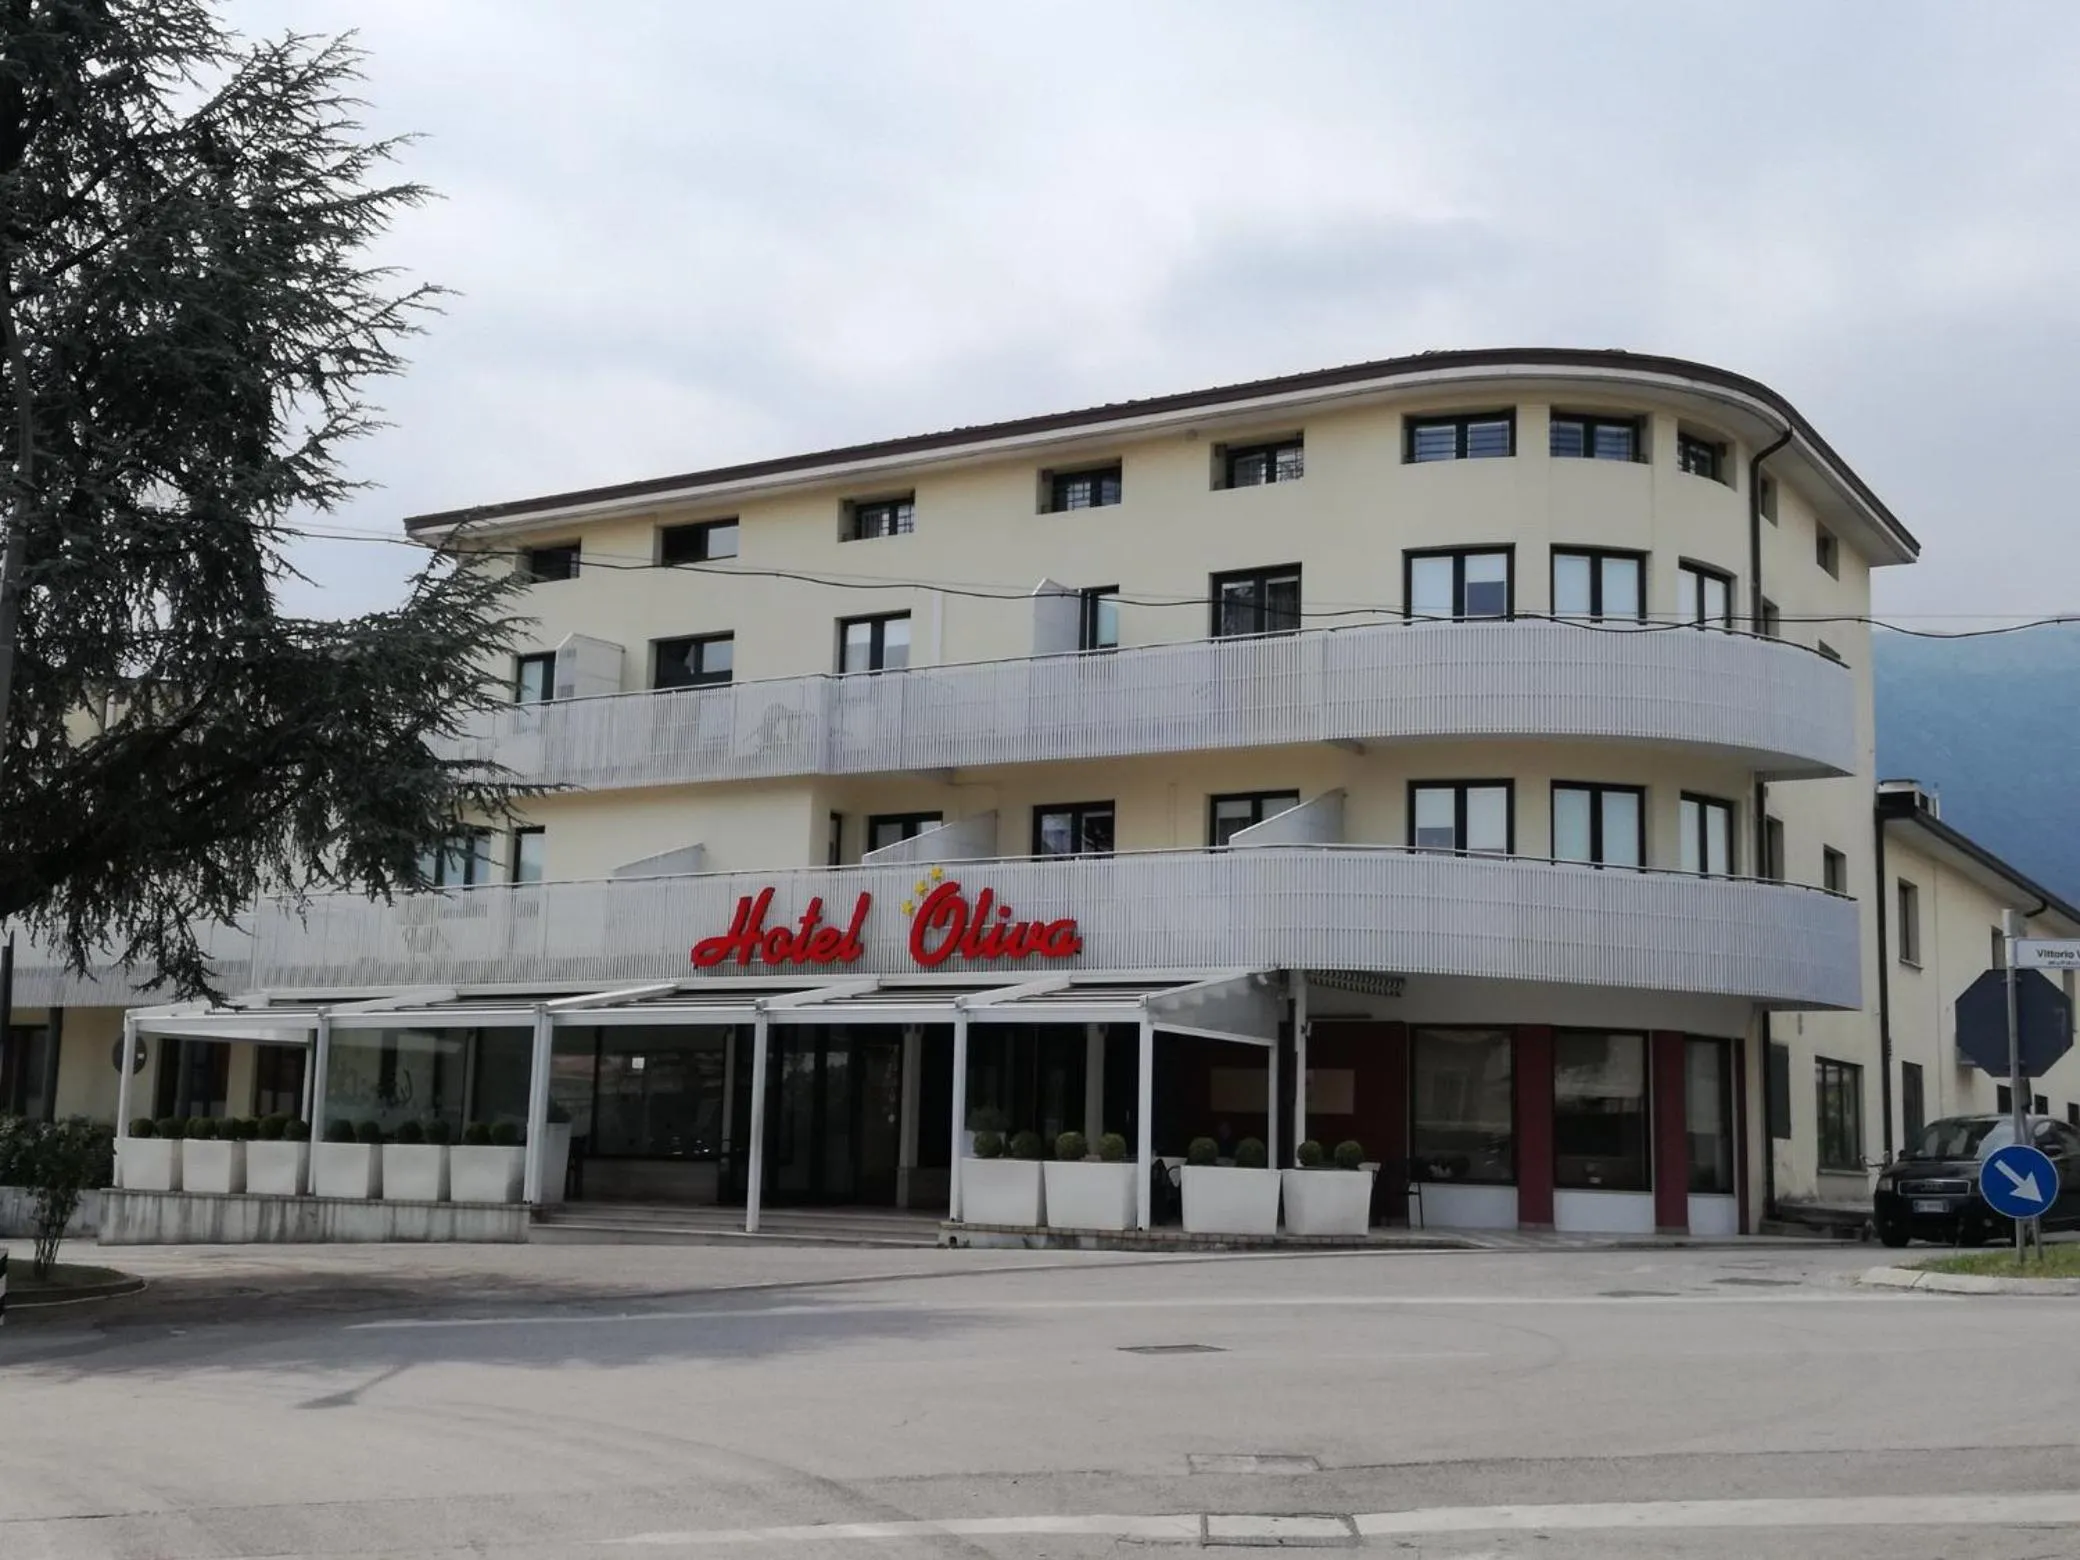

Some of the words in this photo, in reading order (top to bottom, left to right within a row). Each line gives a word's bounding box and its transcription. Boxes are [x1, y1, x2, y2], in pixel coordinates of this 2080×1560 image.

[691, 887, 871, 967] Hotel
[909, 881, 1081, 966] Oliva
[2035, 949, 2075, 959] Vittorio
